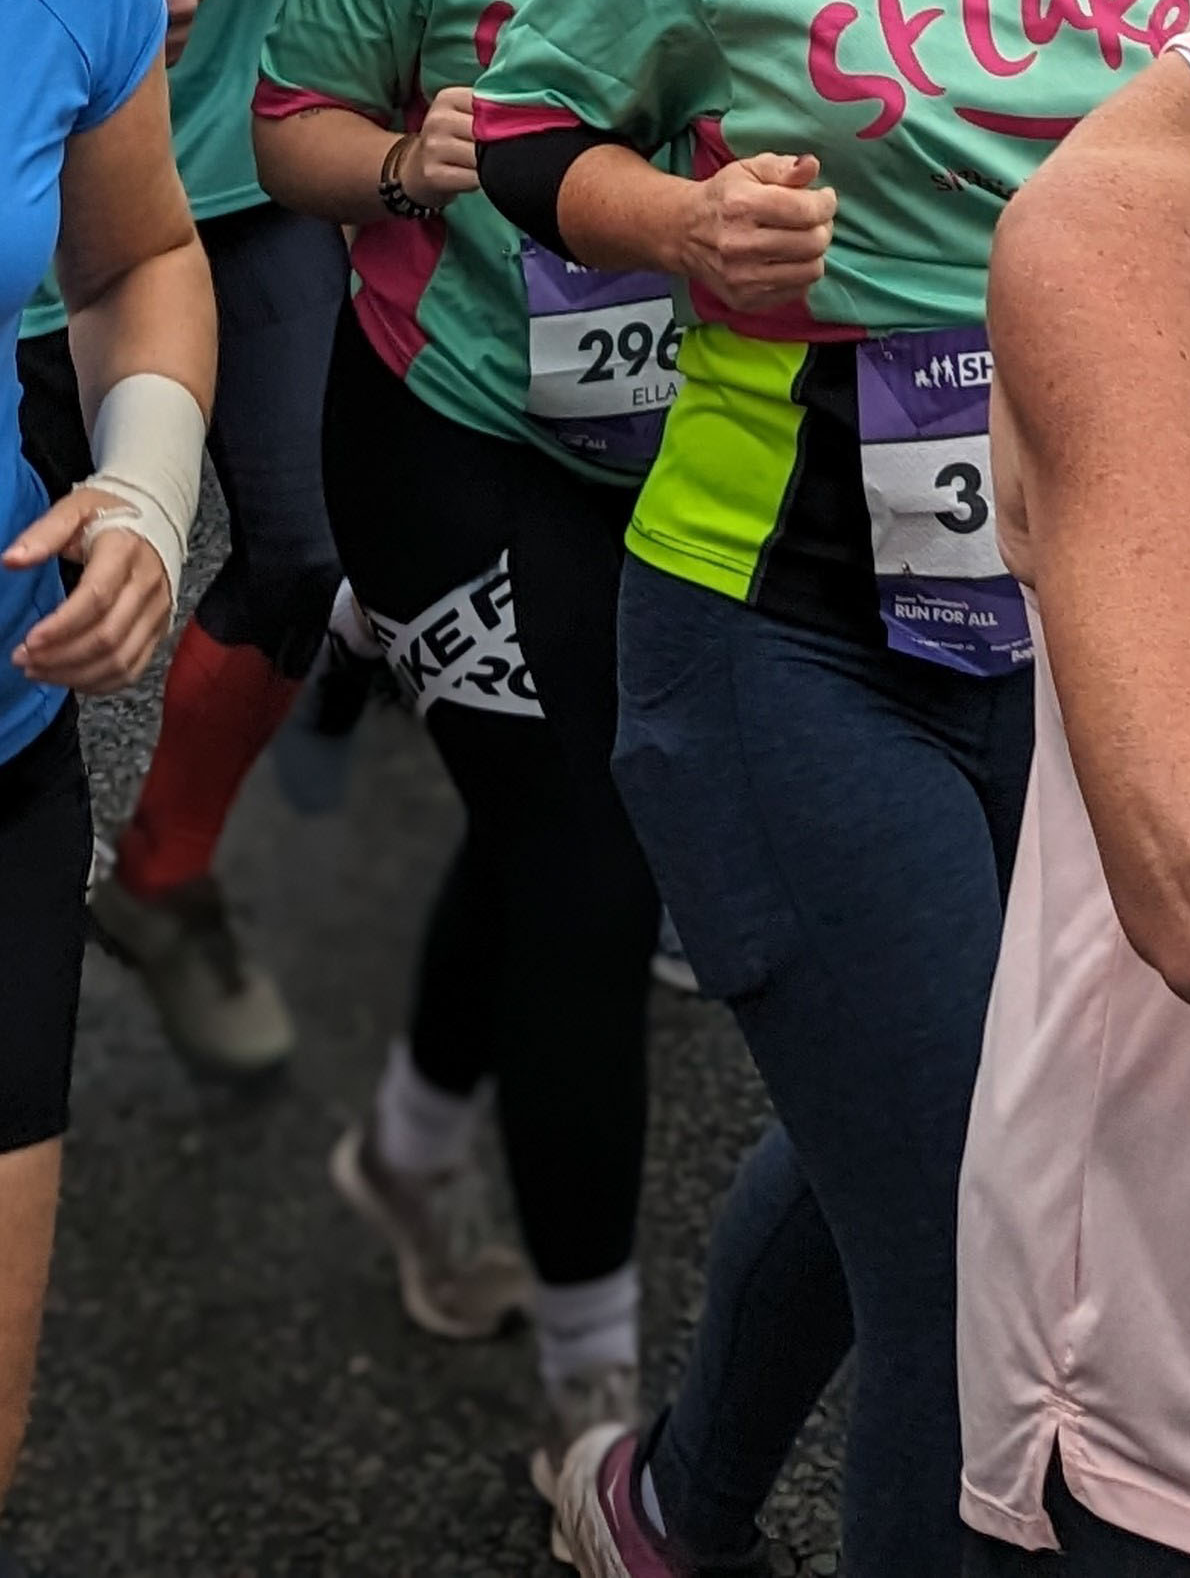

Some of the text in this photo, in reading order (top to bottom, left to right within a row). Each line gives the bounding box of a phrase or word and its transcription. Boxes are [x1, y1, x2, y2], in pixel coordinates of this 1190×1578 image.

[632, 382, 679, 406] ELLA
[935, 462, 989, 534] 3
[895, 603, 998, 626] RUN FOR ALL
